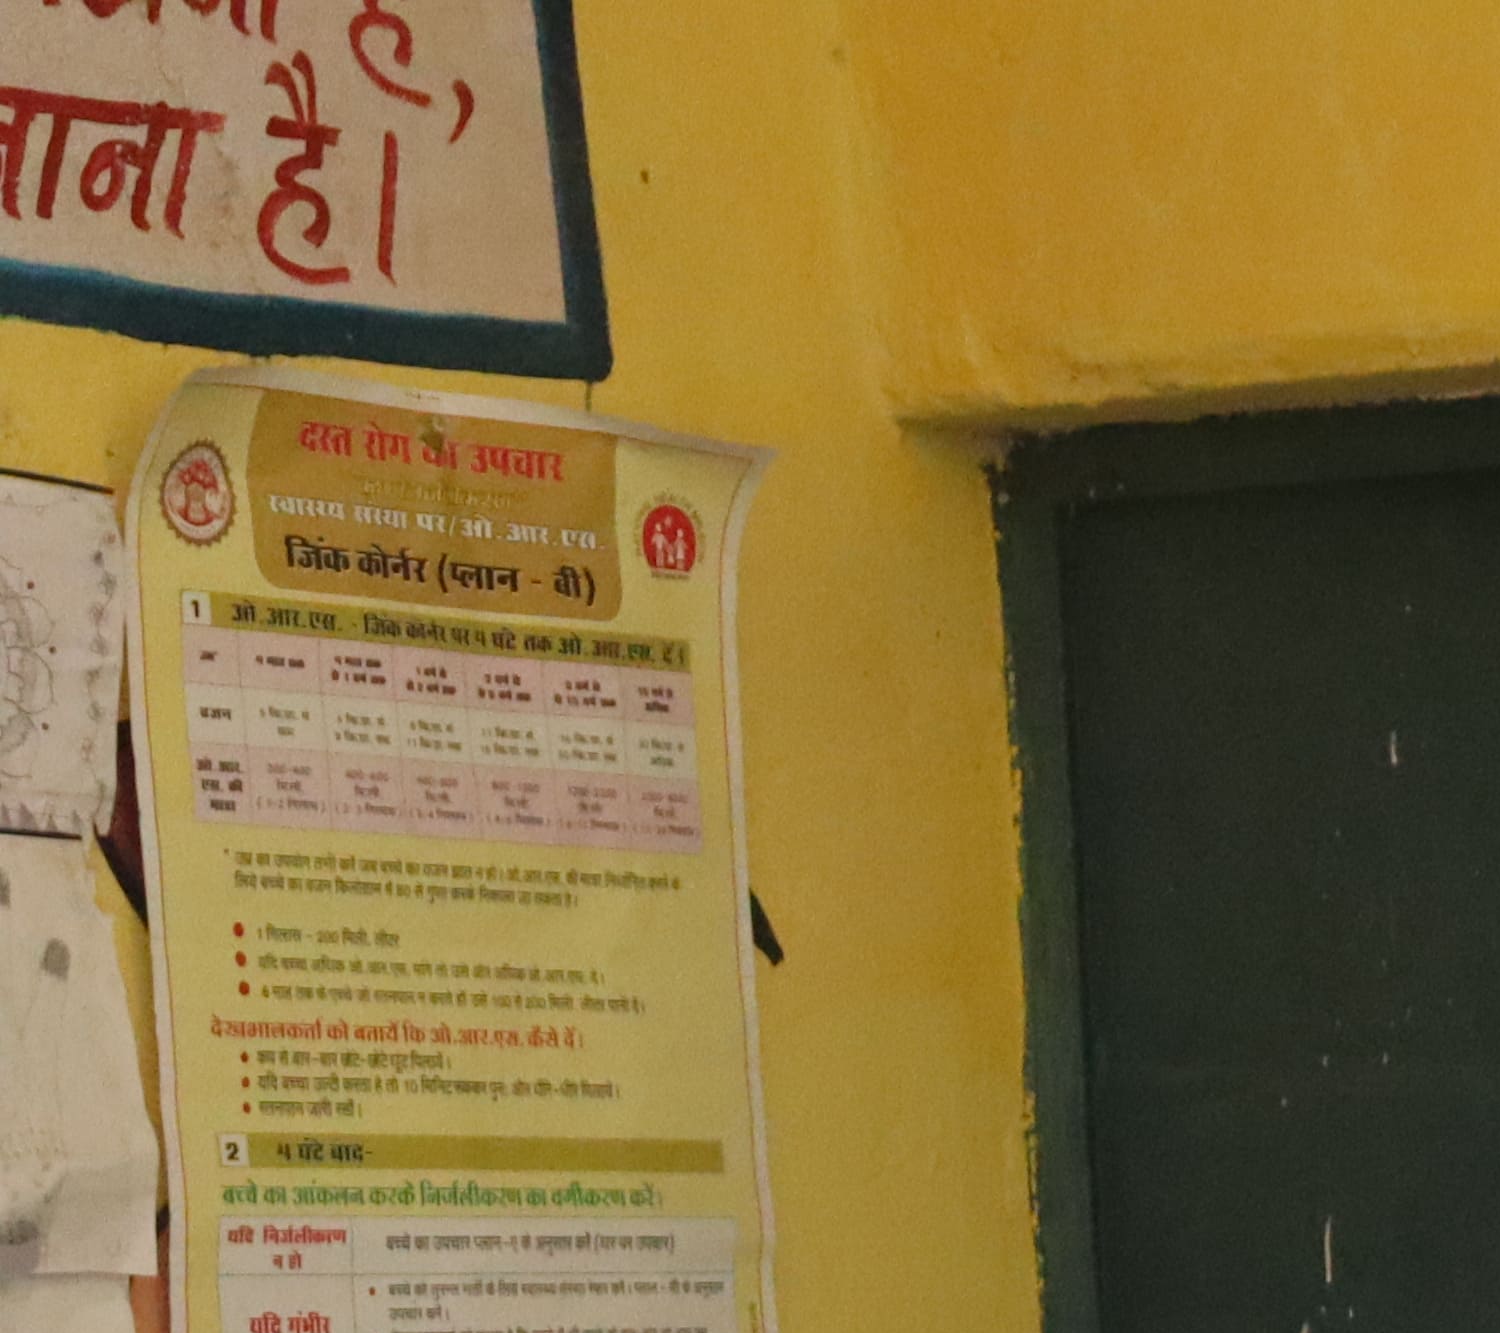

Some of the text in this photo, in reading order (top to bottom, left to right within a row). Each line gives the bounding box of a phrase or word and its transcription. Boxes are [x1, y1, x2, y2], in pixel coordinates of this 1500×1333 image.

[299, 418, 352, 458] दस्त
[360, 418, 412, 468] रोग
[467, 439, 565, 486] उपचार
[285, 534, 350, 576] जिंक
[437, 548, 519, 595] (प्लान
[225, 1143, 240, 1162] 2
